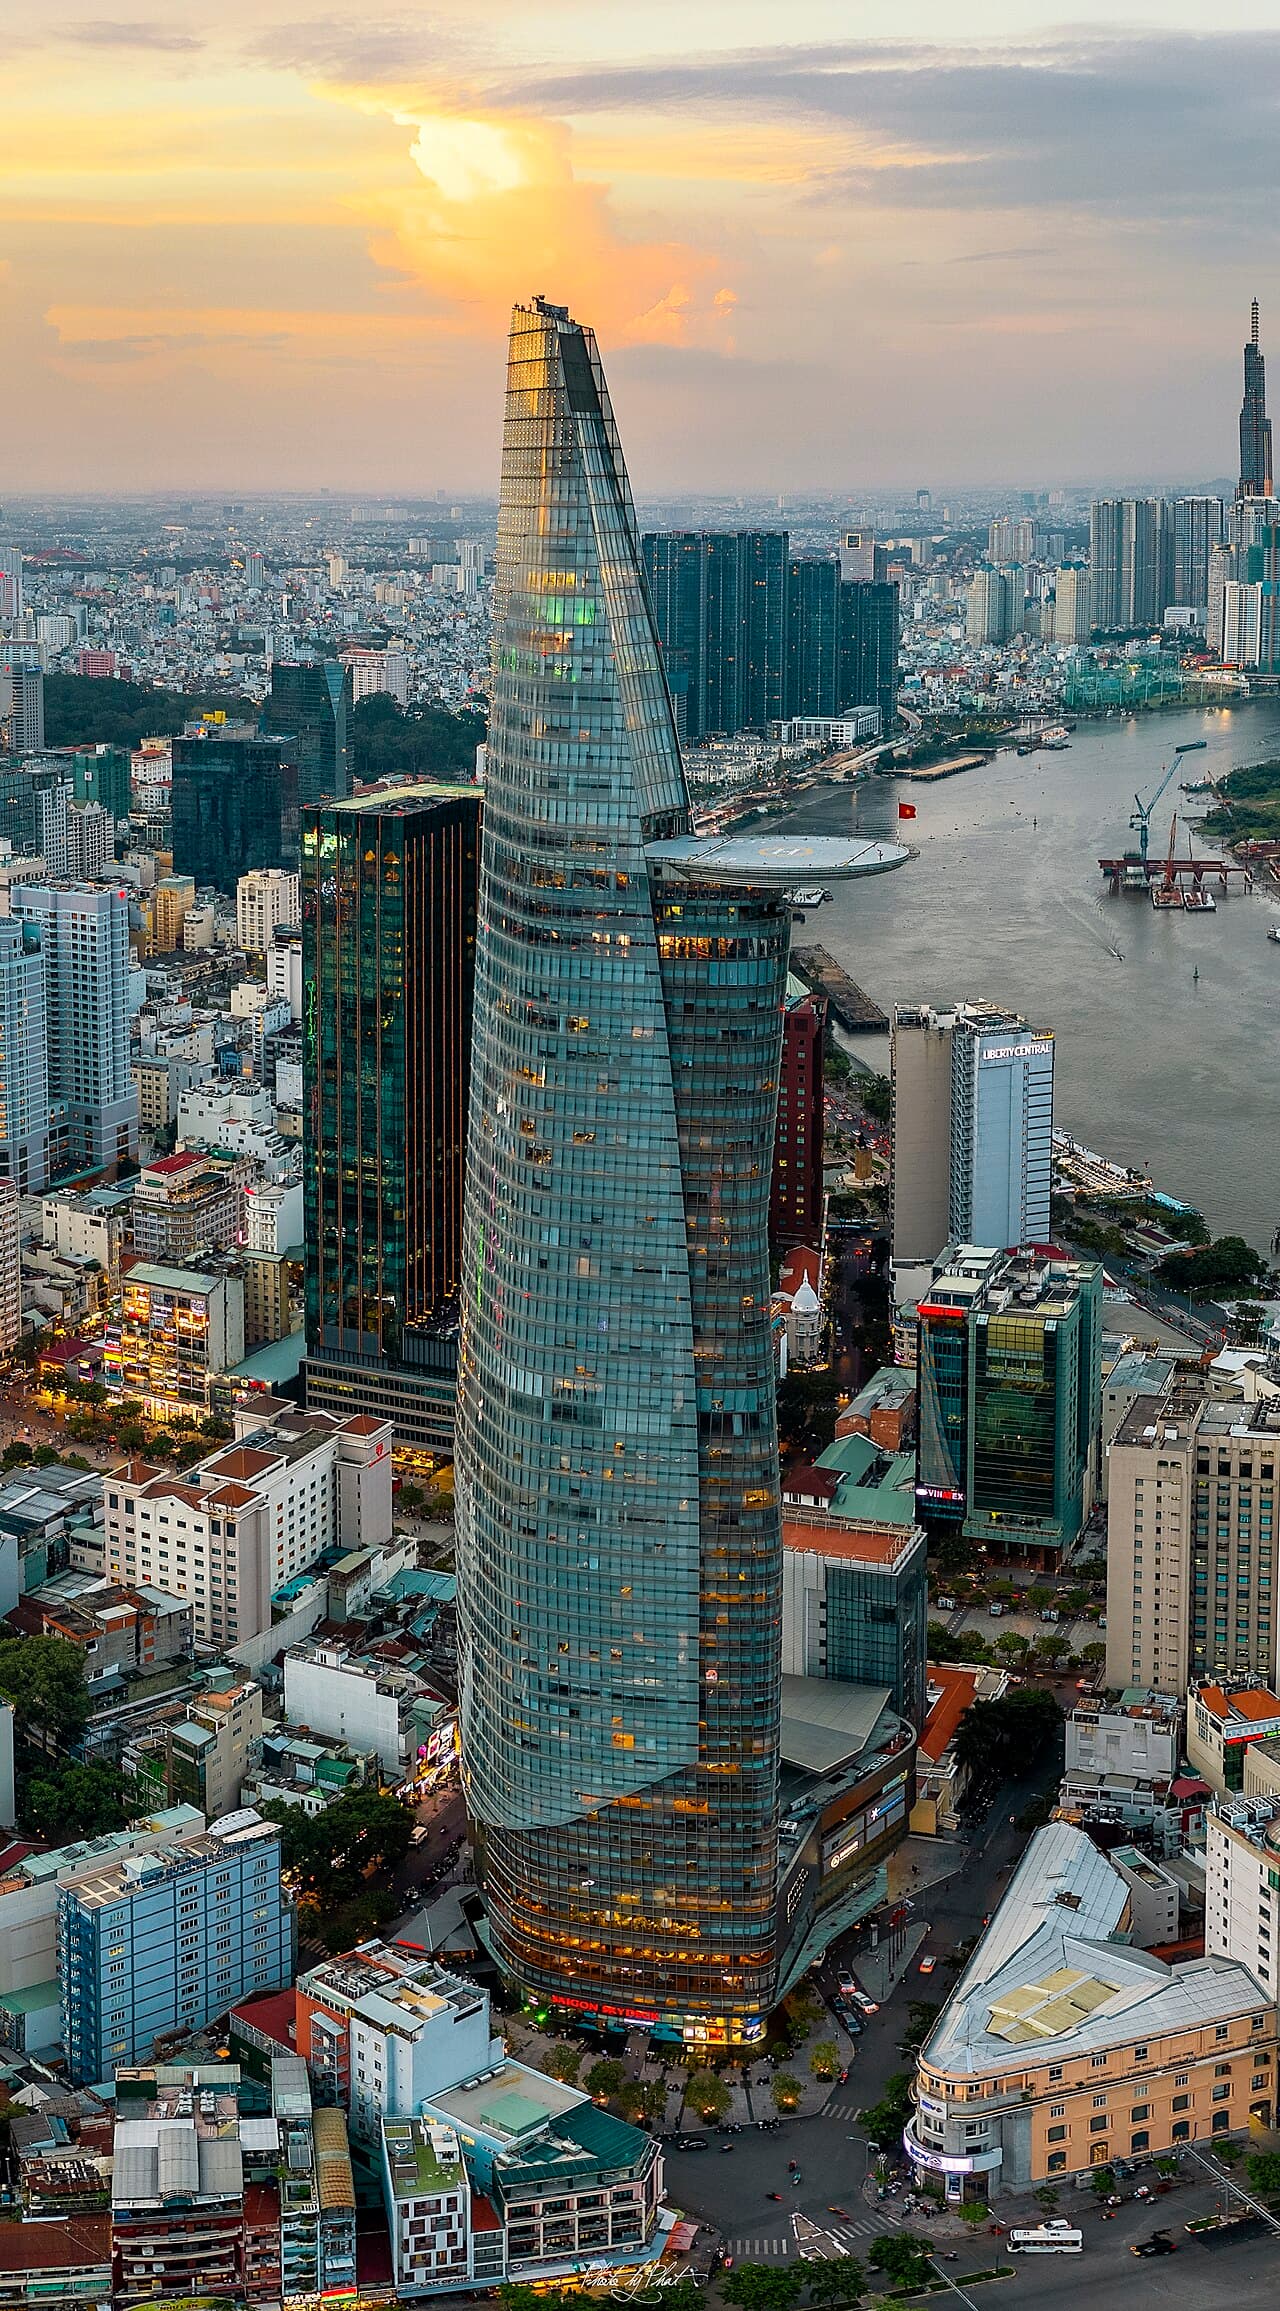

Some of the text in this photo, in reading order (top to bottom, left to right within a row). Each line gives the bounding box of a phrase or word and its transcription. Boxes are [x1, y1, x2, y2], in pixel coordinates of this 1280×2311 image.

[983, 1043, 1051, 1060] LIBERTY CENTRAL
[551, 1995, 660, 2020] SAIGON SKYDECK
